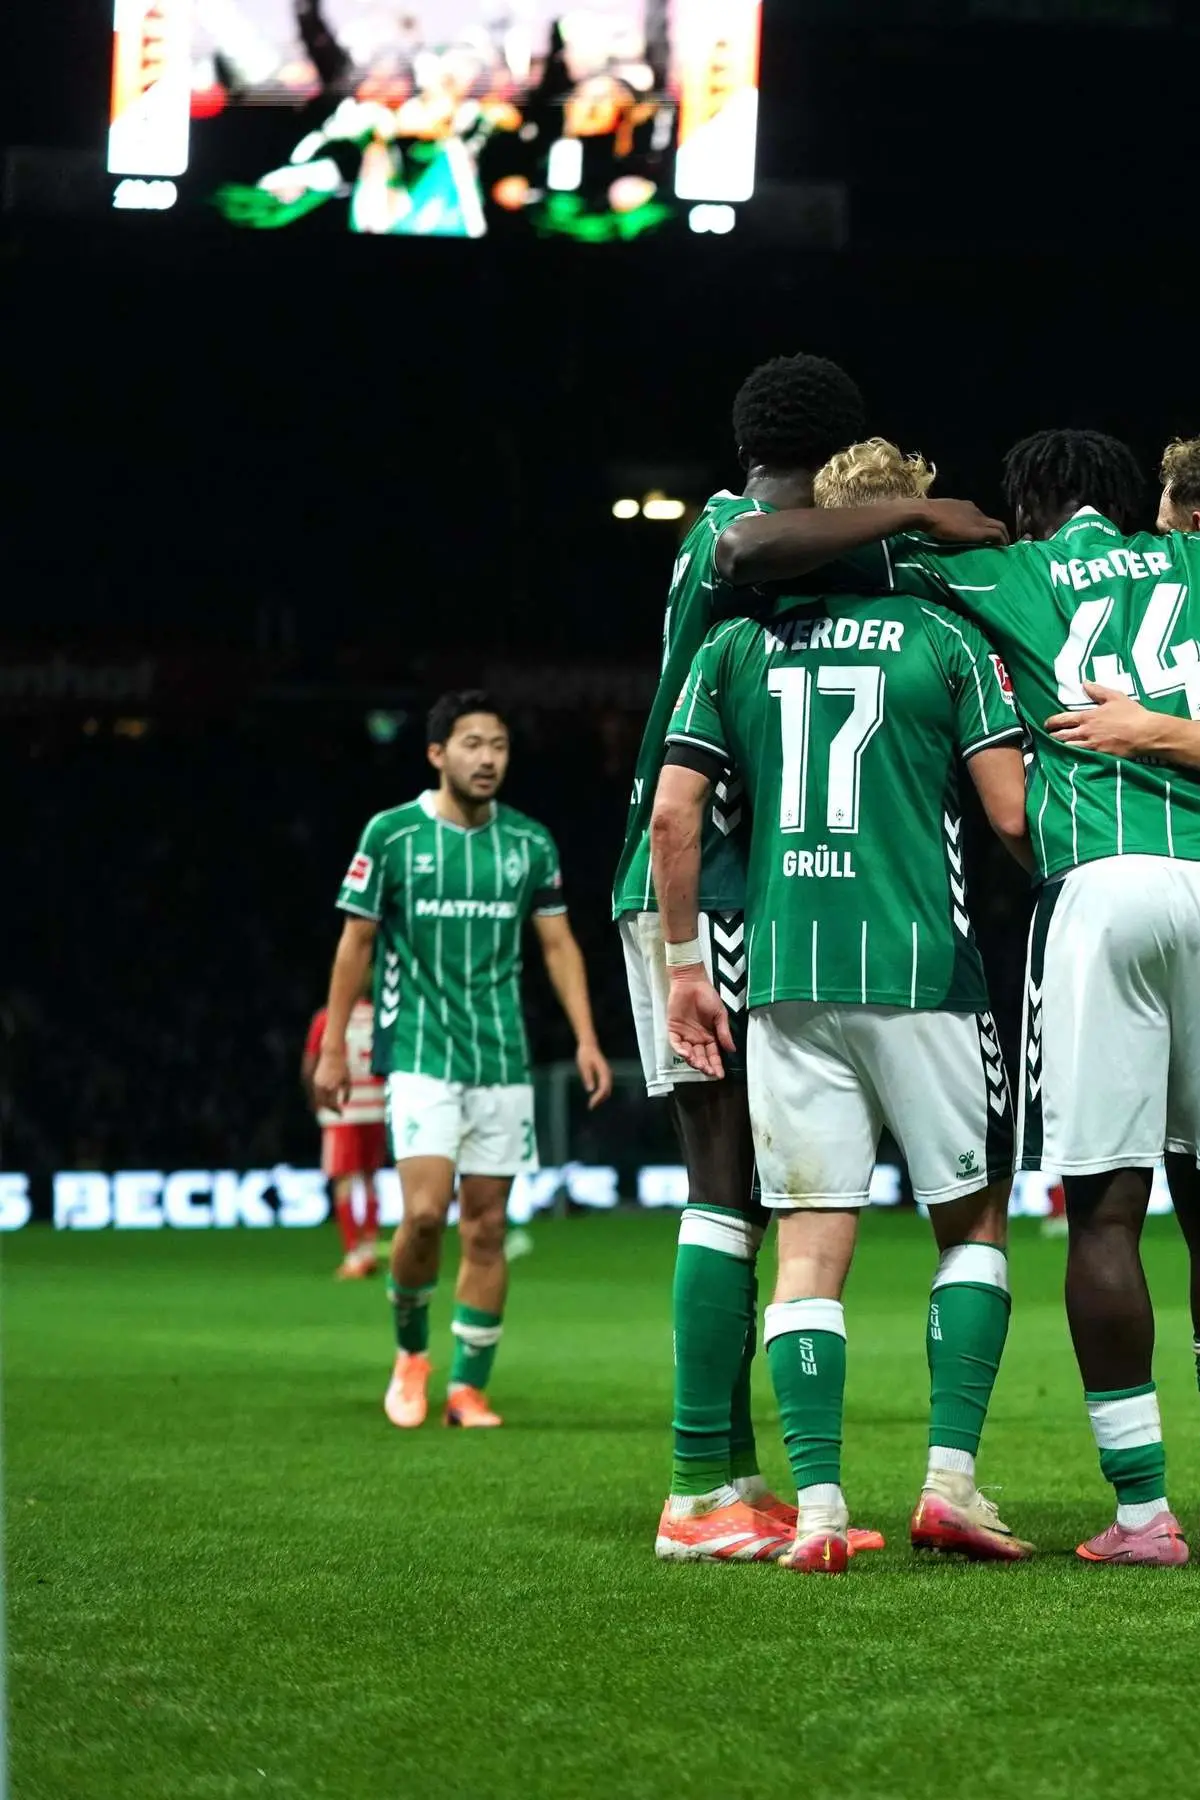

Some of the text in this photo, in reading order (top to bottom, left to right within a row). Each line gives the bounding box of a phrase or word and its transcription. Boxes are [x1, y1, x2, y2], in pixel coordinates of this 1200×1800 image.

[764, 617, 904, 653] WERDER
[767, 666, 886, 834] 17
[782, 844, 856, 877] GRÜLL
[54, 1164, 331, 1229] BECK'S
